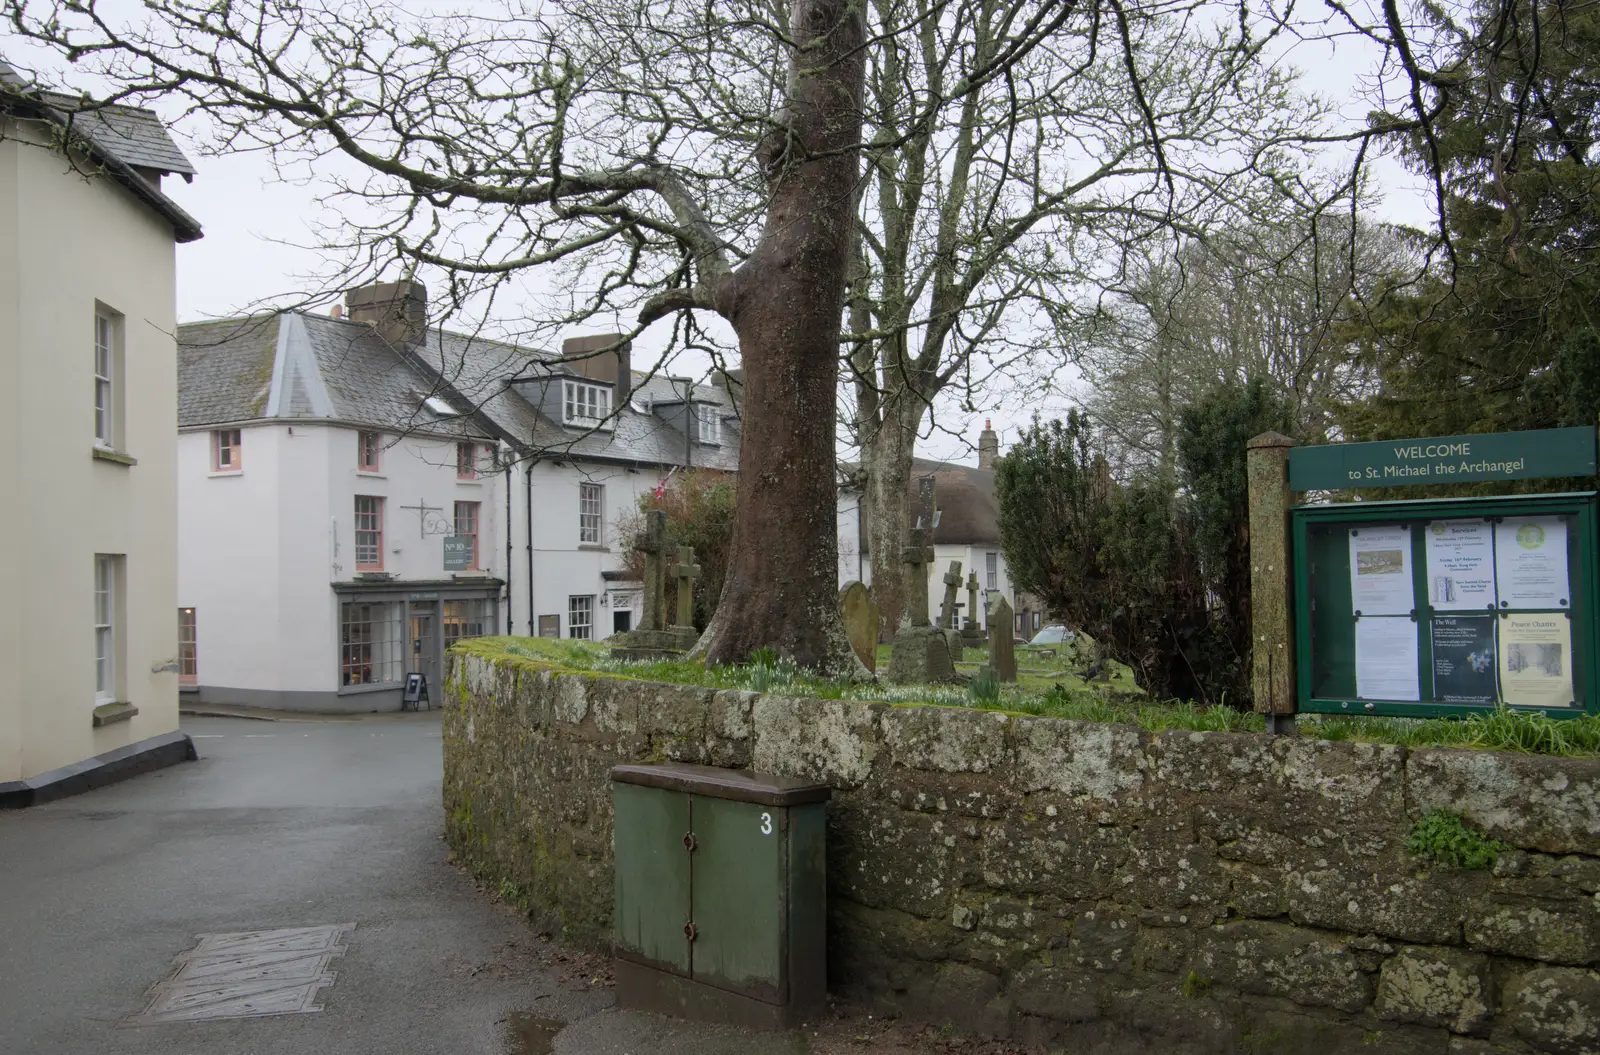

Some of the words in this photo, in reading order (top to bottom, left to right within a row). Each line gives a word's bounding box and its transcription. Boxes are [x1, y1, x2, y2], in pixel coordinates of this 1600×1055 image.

[1394, 442, 1471, 459] WELCOME
[1348, 470, 1362, 480] to
[1365, 467, 1380, 478] St.
[1384, 463, 1430, 477] Michael
[1435, 463, 1456, 474] the
[1458, 458, 1524, 474] Archangel
[456, 543, 465, 551] 10
[1532, 620, 1557, 628] Chants
[760, 812, 773, 835] 3
